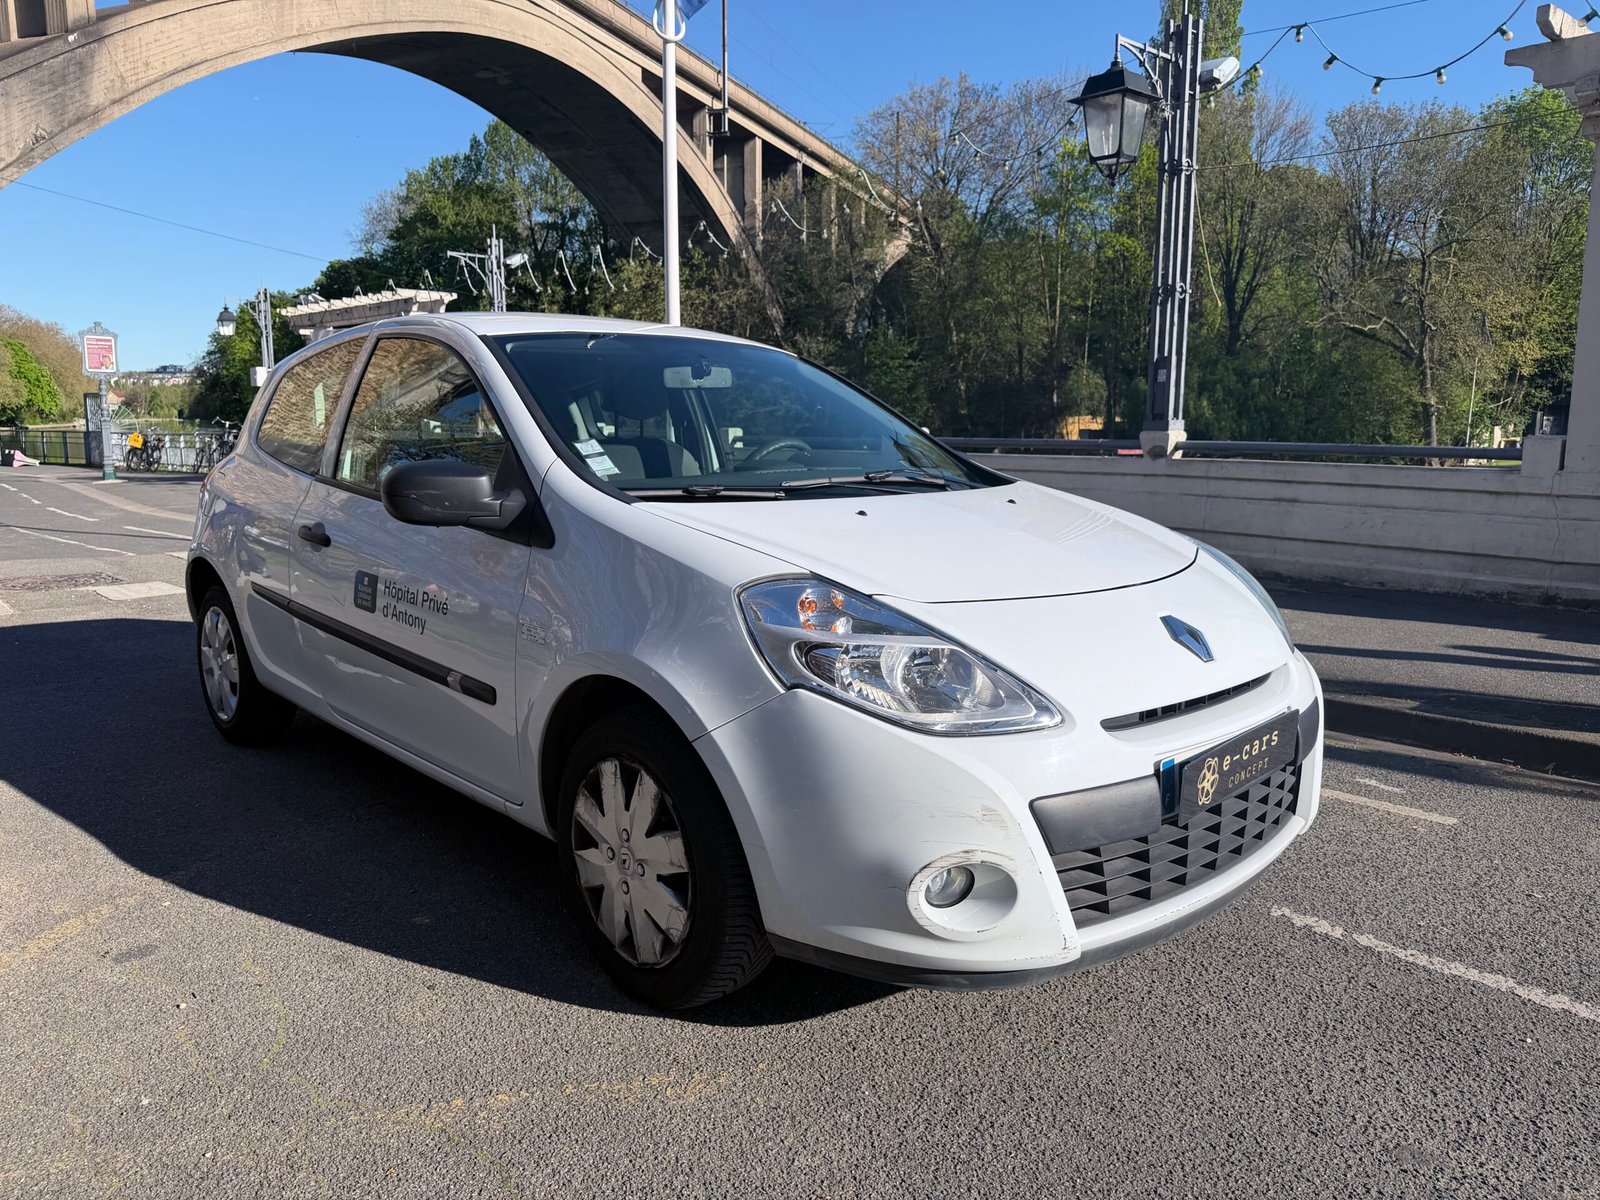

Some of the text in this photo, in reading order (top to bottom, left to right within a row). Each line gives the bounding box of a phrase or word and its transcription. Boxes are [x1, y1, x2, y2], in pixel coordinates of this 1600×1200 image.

[383, 579, 419, 606] Hôpital
[421, 590, 449, 615] Privé
[382, 602, 426, 635] d'Antony
[1222, 730, 1279, 771] e-cars
[1228, 757, 1269, 788] CONCEPT
